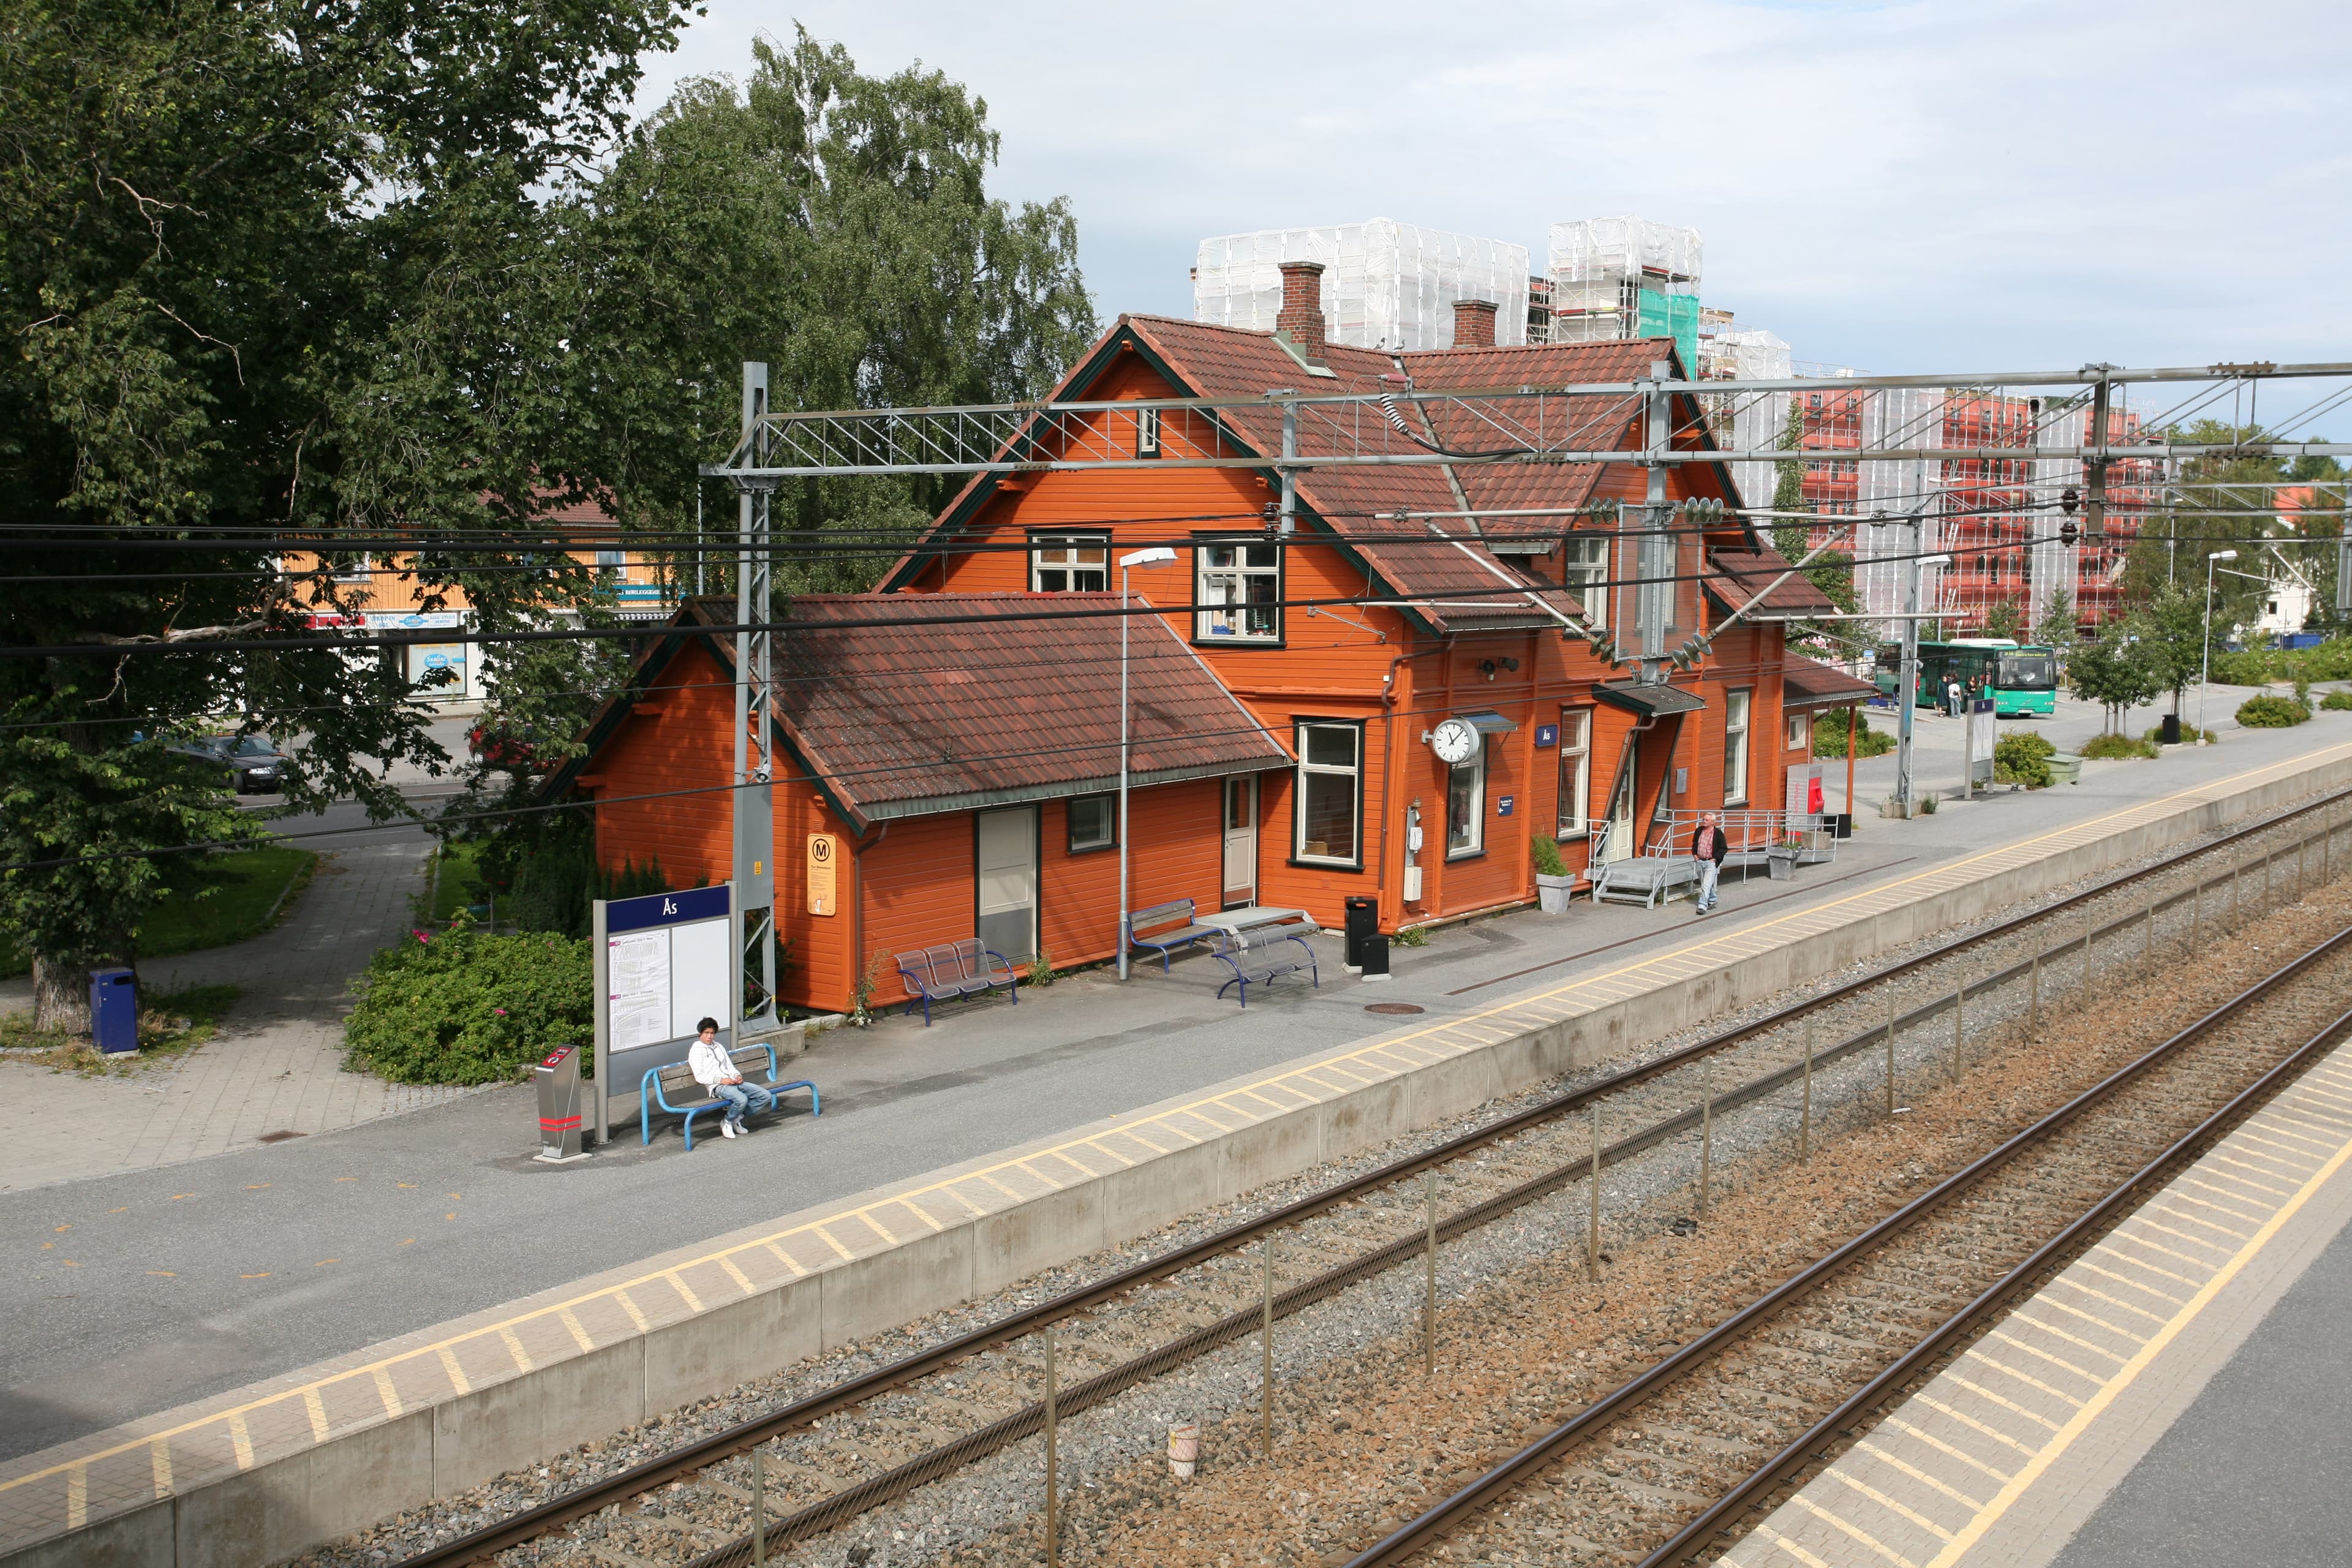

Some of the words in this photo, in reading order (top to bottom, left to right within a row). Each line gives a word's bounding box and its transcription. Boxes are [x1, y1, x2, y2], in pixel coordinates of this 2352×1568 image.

[1543, 729, 1551, 741] Ås
[816, 843, 826, 857] M
[663, 897, 677, 916] Ås
